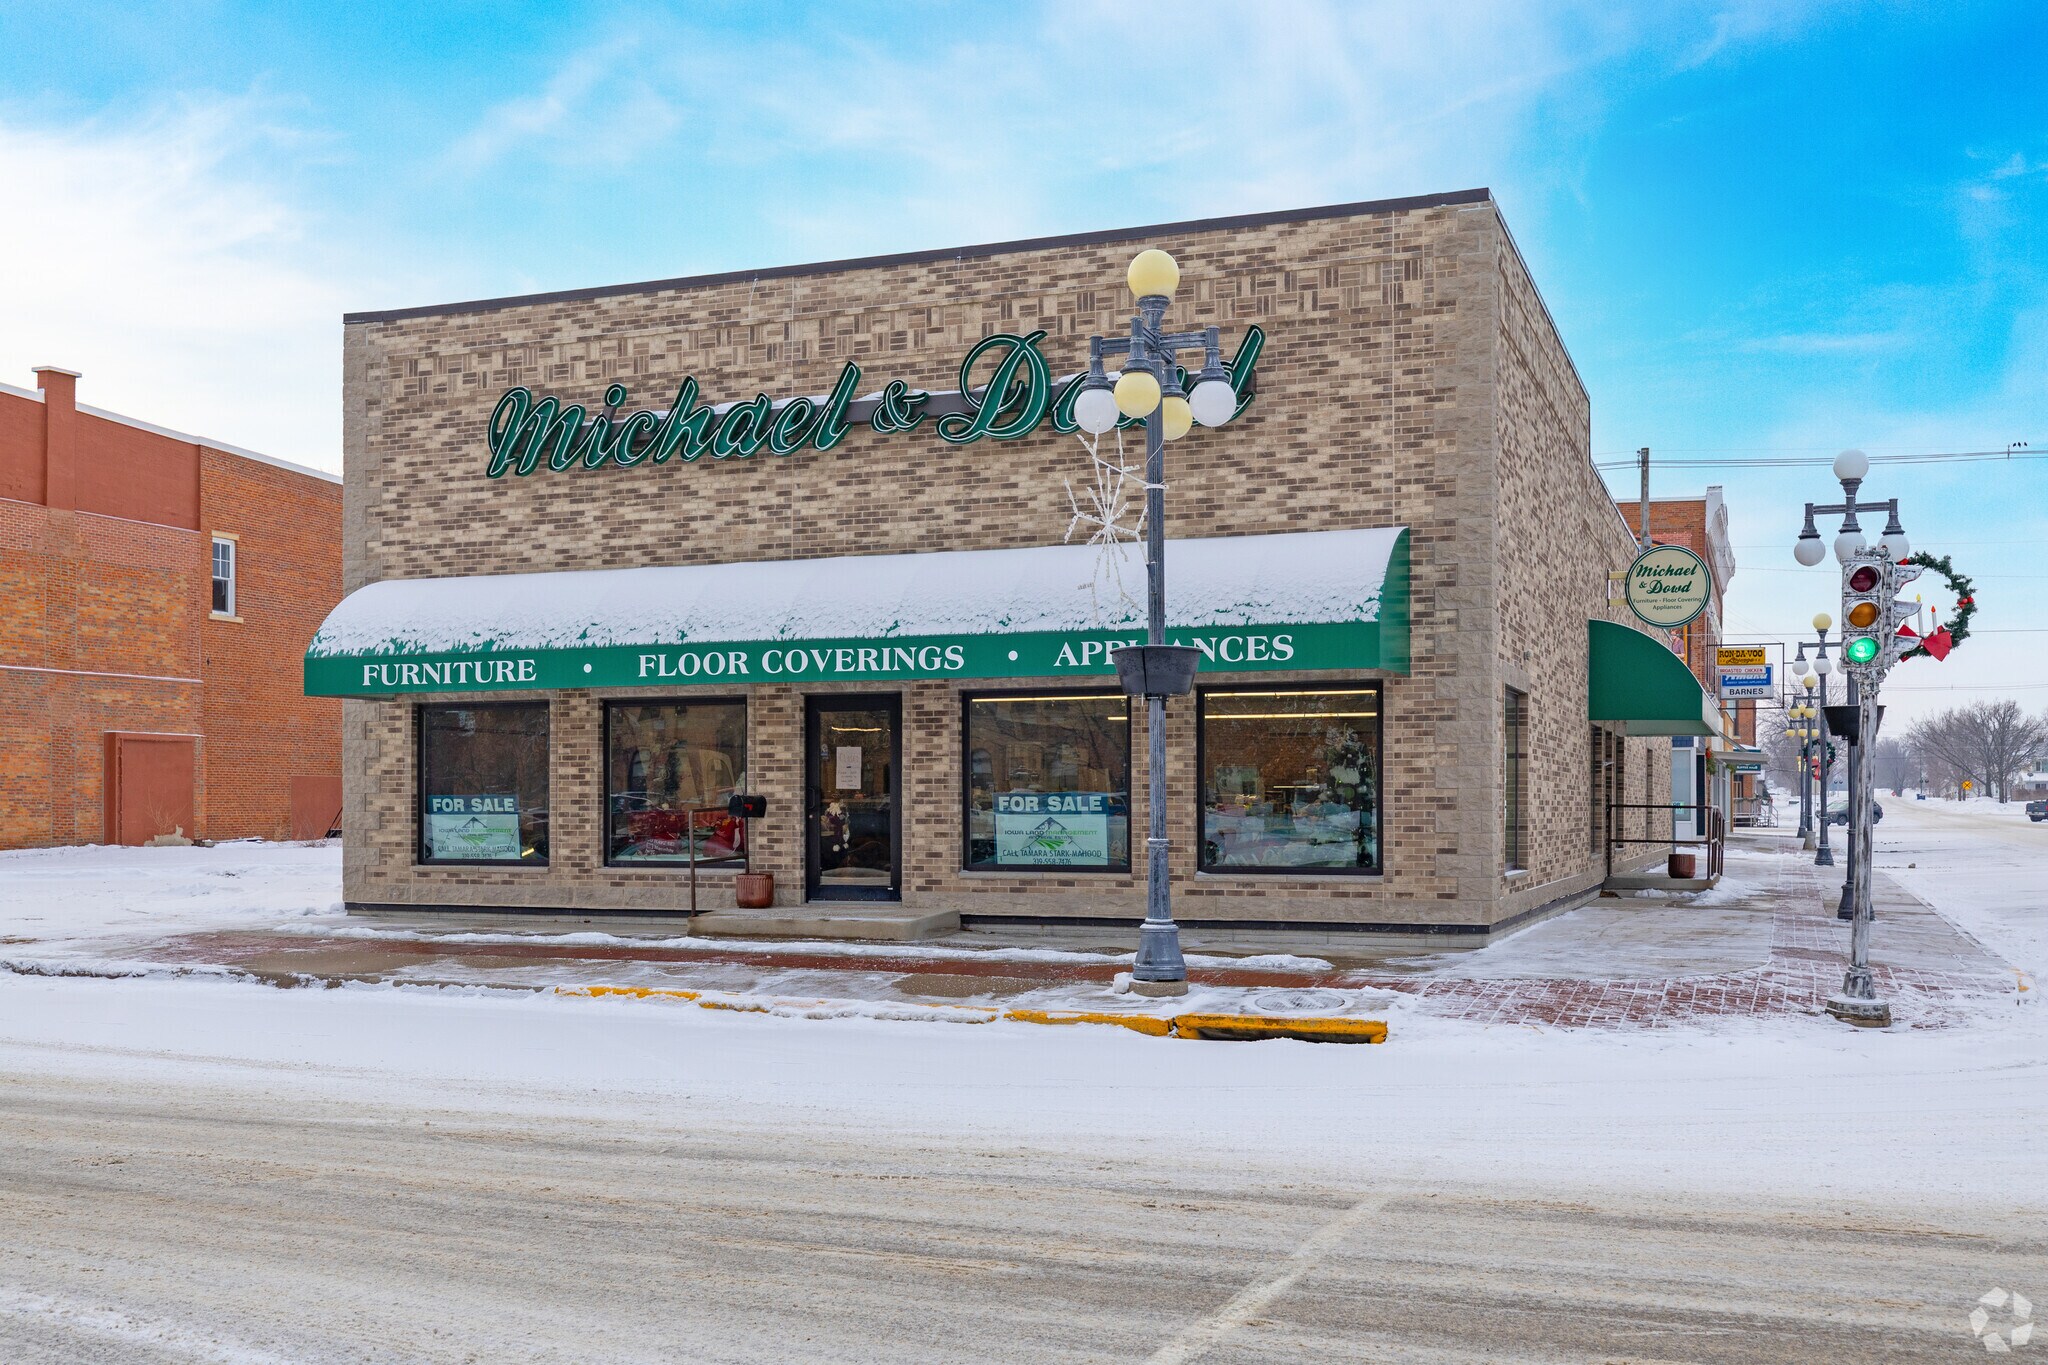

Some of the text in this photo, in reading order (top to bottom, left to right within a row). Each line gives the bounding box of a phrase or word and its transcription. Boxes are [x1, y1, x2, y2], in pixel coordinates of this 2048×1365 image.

[486, 360, 862, 478] Michael
[871, 379, 930, 434] &
[1636, 563, 1698, 577] Michael
[1646, 580, 1692, 595] Dowd
[362, 634, 1294, 686] FURNITURE FLOOR COVERINGS APPNCES
[1729, 688, 1764, 696] BARNES
[432, 798, 515, 812] FOR SALE
[998, 796, 1102, 812] FOR SALE
[1021, 849, 1048, 857] TAMARA
[1049, 849, 1102, 858] STARK-MAHOOD
